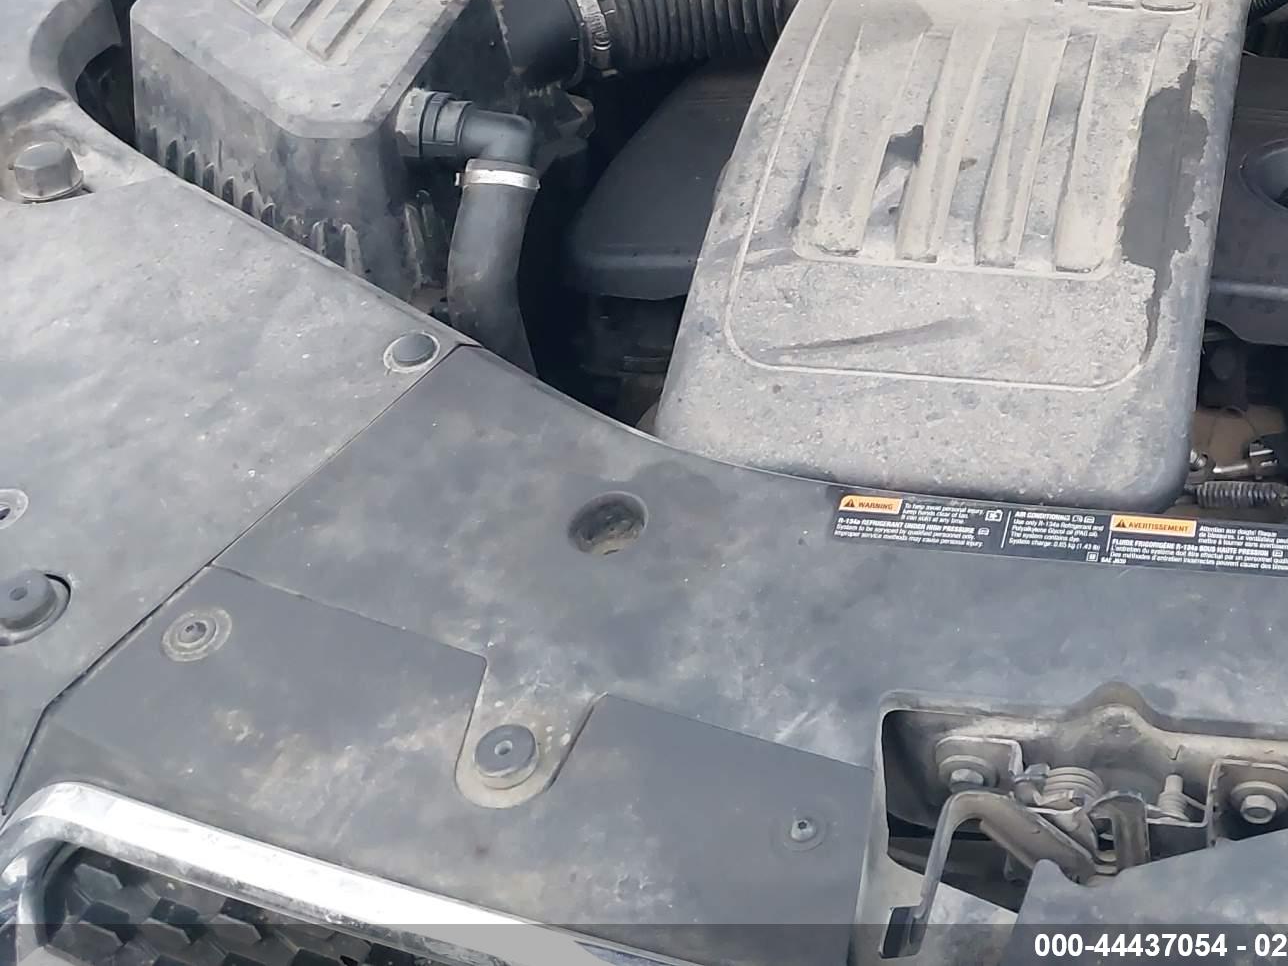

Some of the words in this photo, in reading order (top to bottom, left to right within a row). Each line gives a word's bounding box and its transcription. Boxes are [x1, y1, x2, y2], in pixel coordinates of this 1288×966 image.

[858, 501, 893, 510] WARNING
[1026, 512, 1071, 521] CONDITIONING
[861, 519, 904, 528] REFRIGERANT
[1128, 521, 1189, 532] AVERTISSEMENT
